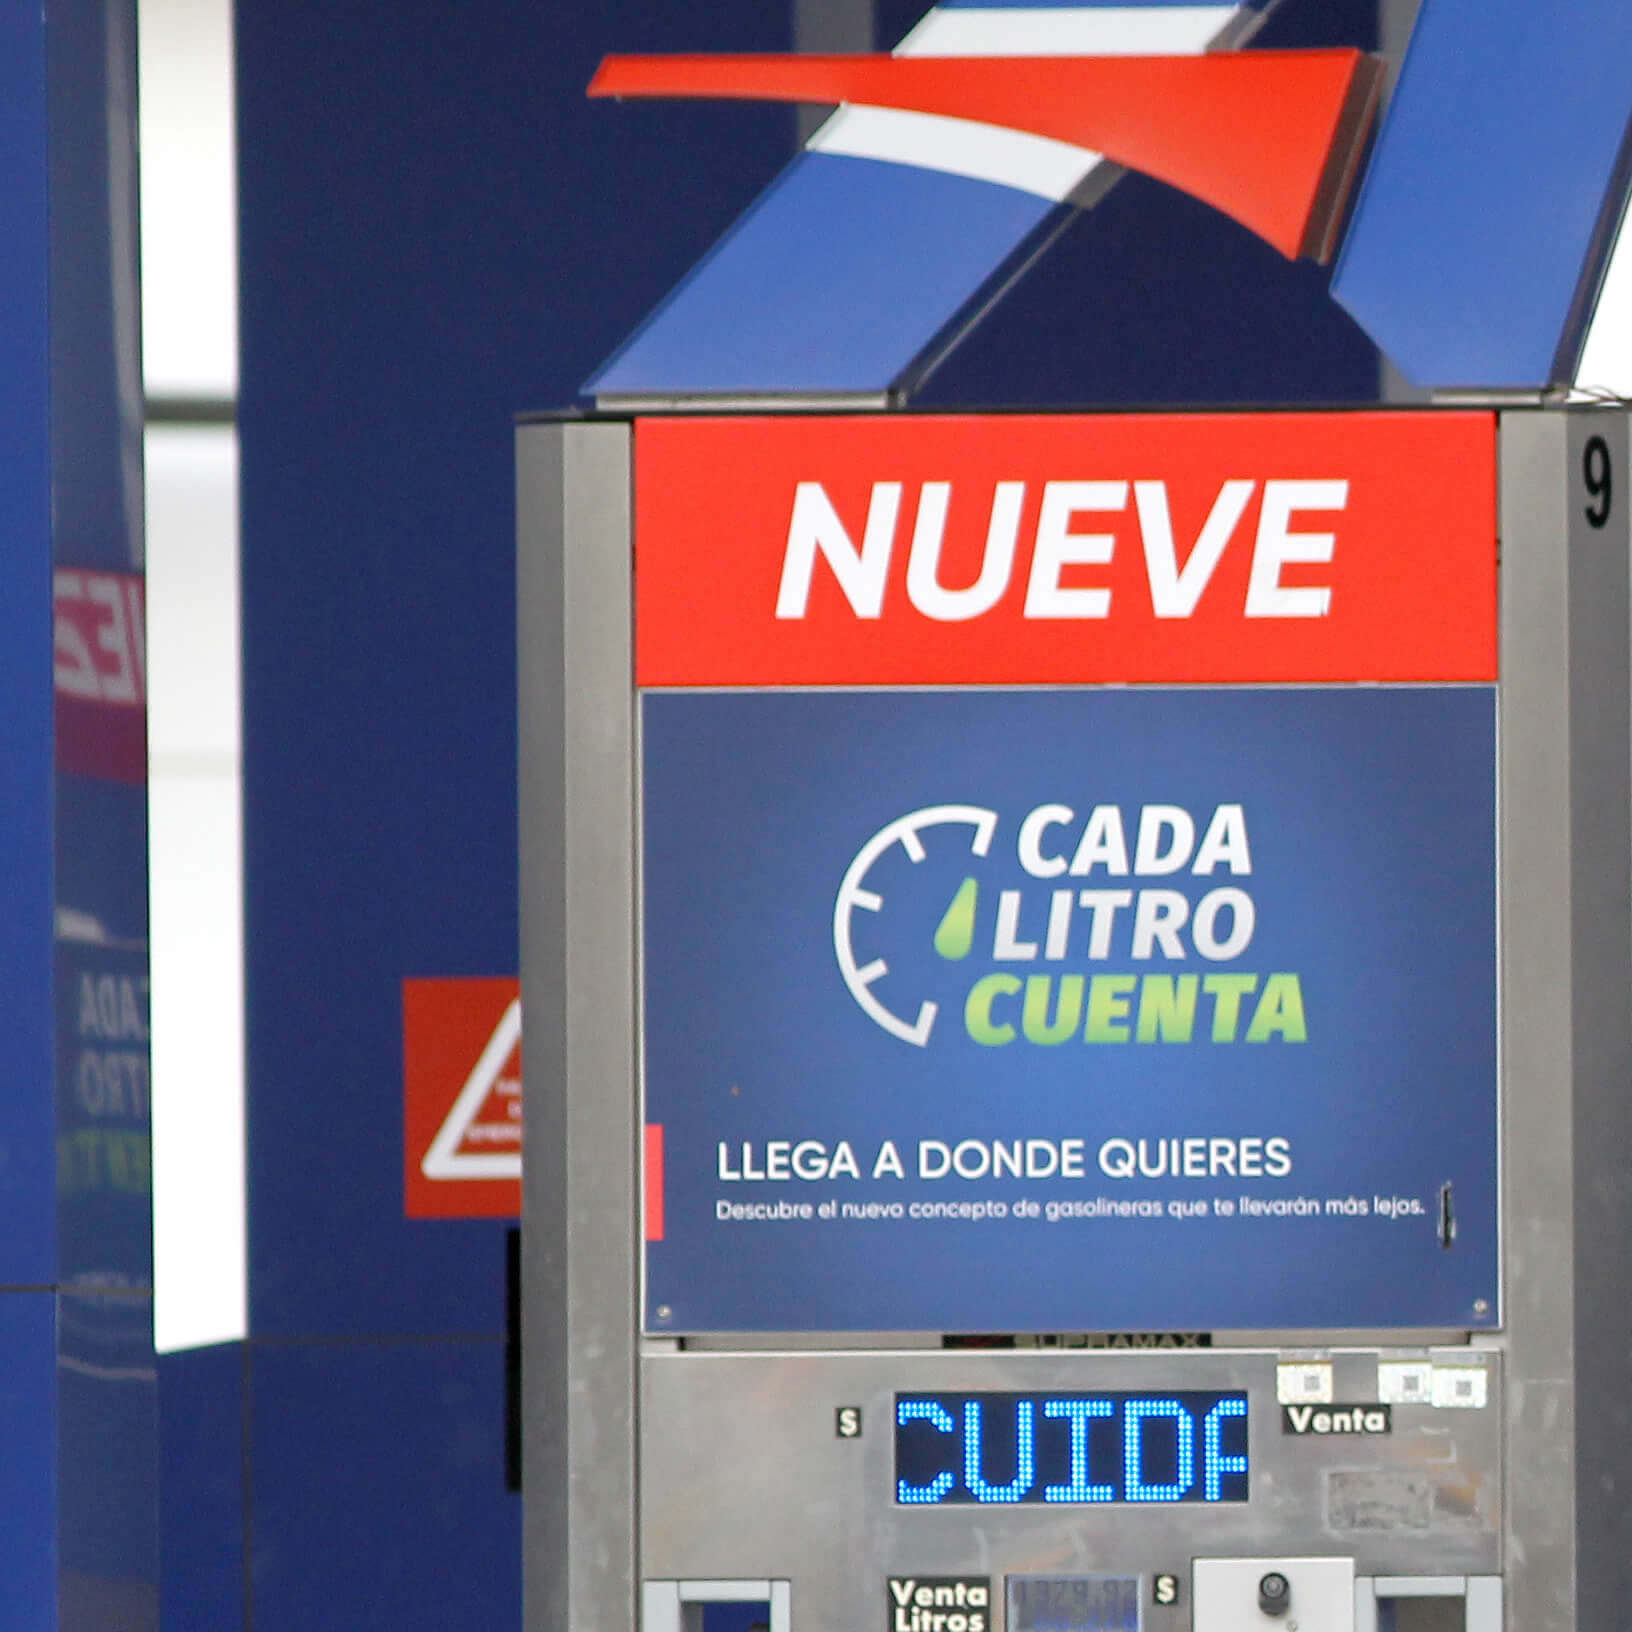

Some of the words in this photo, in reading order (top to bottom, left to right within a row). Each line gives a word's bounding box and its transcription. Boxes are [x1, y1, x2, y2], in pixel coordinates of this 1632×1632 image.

[1582, 435, 1612, 530] 9
[775, 480, 1350, 621] NUEVE
[1017, 803, 1252, 878] CADA
[992, 887, 1257, 962] LITRO
[964, 972, 1308, 1048] CUENTA
[718, 1141, 860, 1180] LLEGA
[872, 1141, 905, 1179] A
[919, 1139, 1085, 1179] DONDE
[1098, 1138, 1292, 1178] QUIERES
[716, 1199, 813, 1221] Descubre
[818, 1199, 836, 1219] el
[841, 1203, 902, 1219] nuevo
[908, 1199, 1007, 1222] concepto
[1012, 1199, 1040, 1219] de
[1046, 1197, 1162, 1222] gasolineras
[1168, 1201, 1207, 1220] que
[1213, 1199, 1235, 1217] te
[1239, 1197, 1321, 1217] llevarán
[1325, 1197, 1368, 1216] más
[1374, 1195, 1425, 1219] lejos.
[1287, 1408, 1385, 1432] Venta
[889, 1580, 988, 1607] Venta
